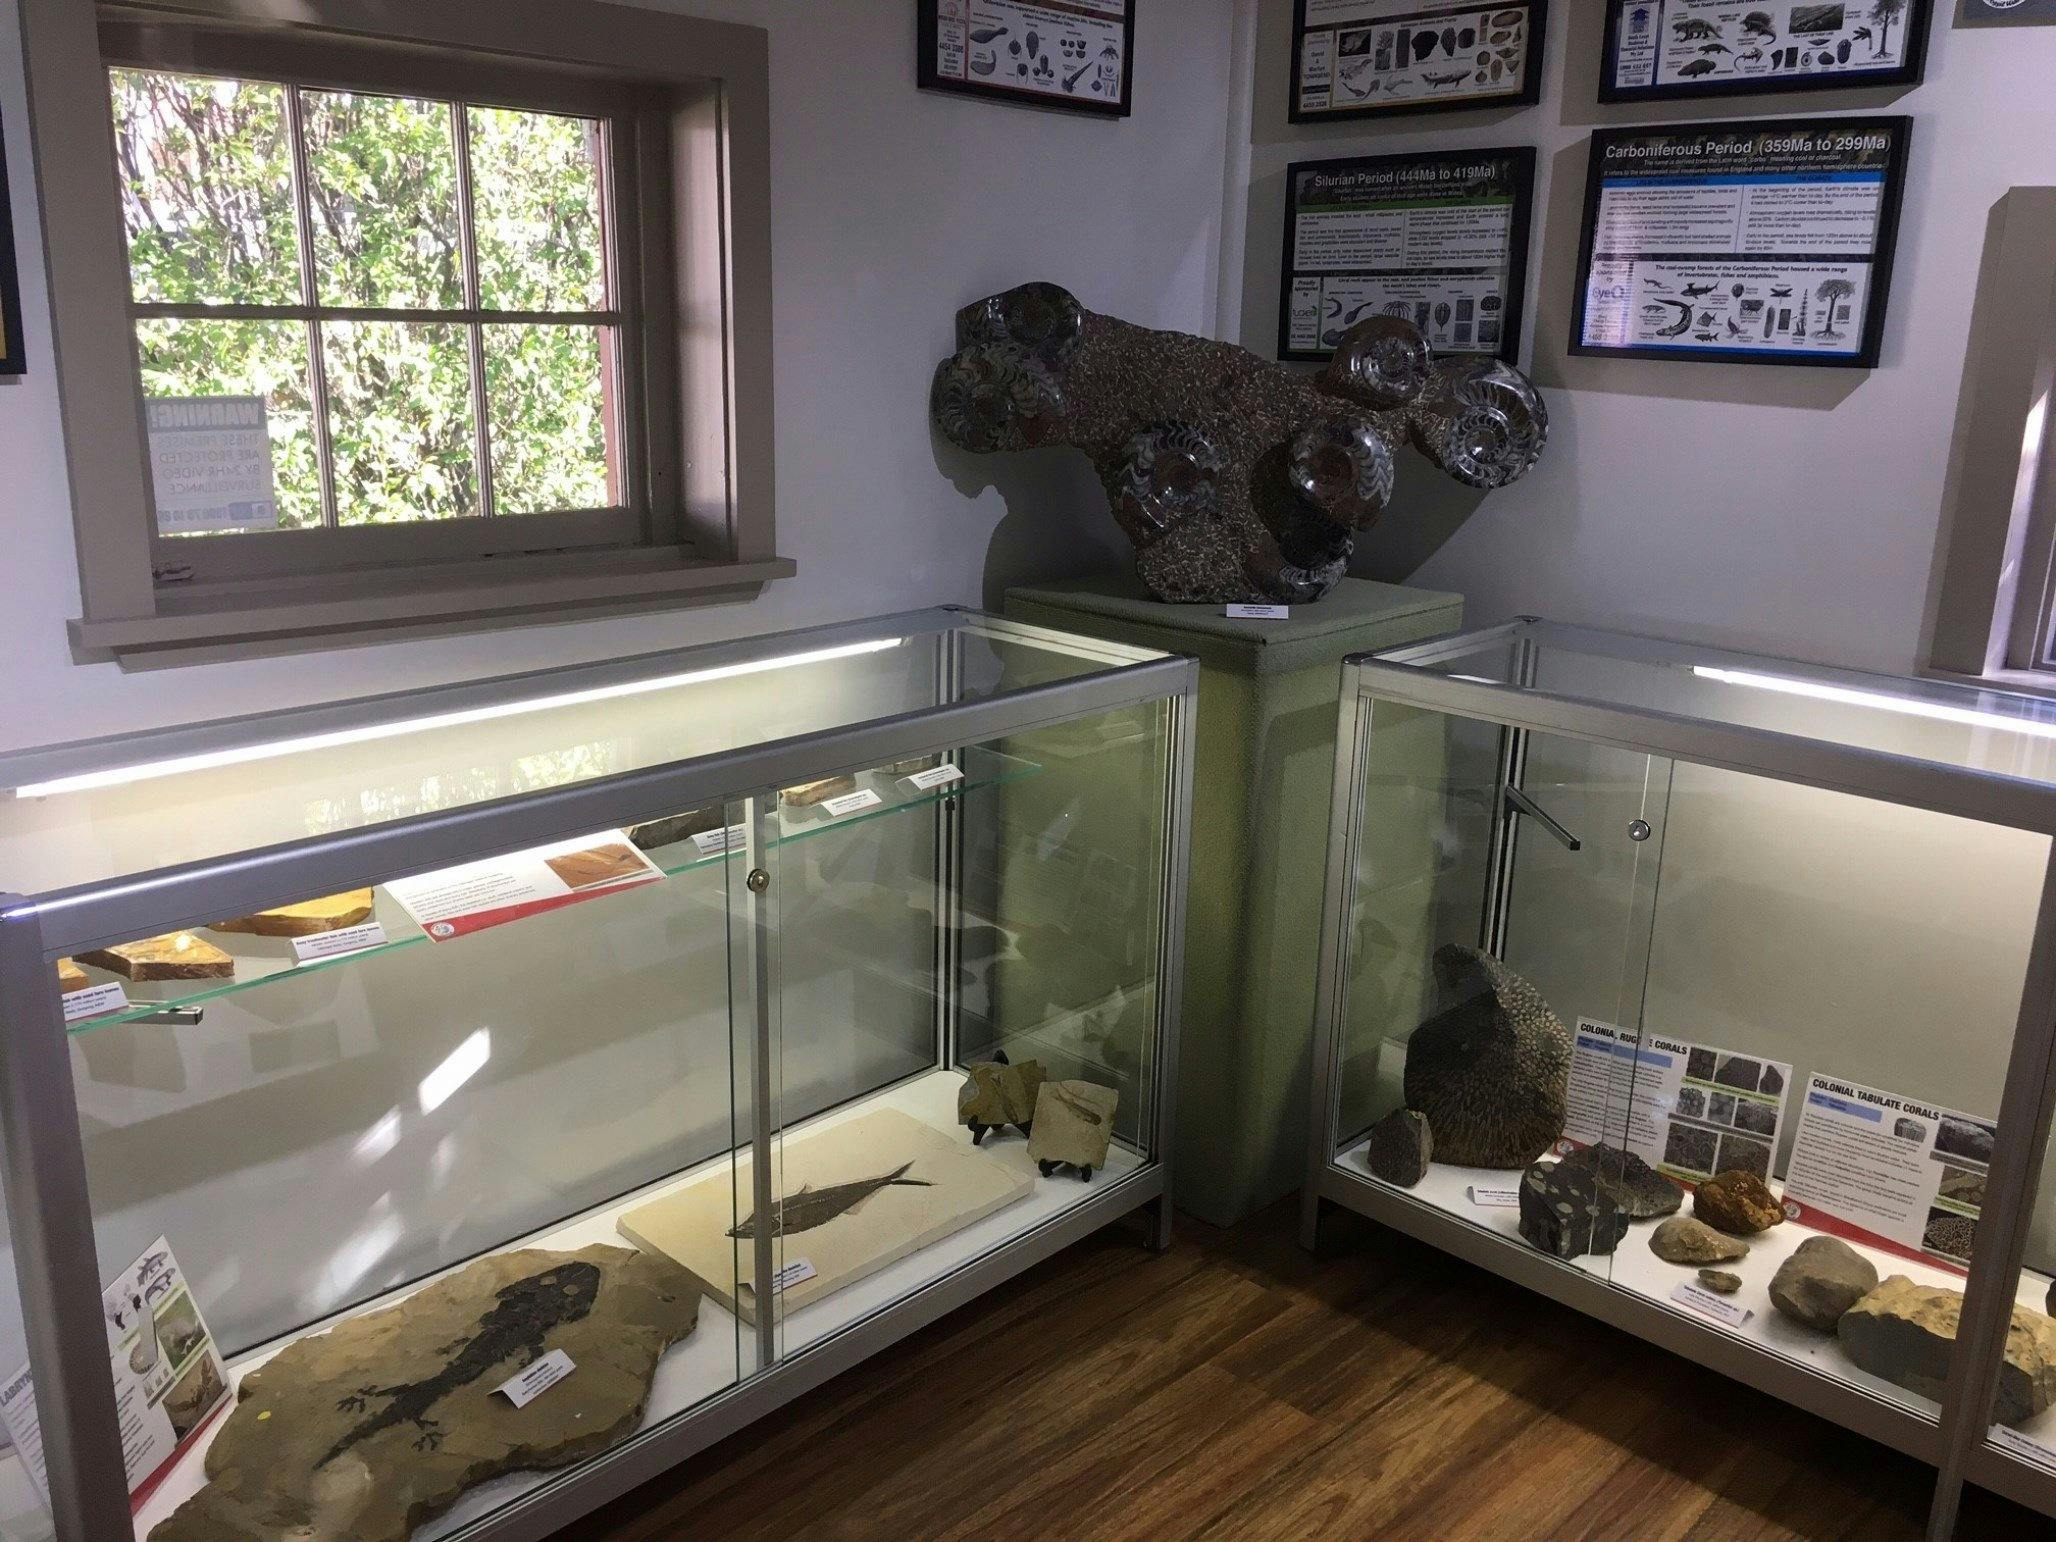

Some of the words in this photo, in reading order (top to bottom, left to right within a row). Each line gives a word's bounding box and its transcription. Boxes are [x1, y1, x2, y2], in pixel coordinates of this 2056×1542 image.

[1606, 143, 1702, 159] Carboniferous
[1706, 140, 1752, 155] Period
[1759, 138, 1812, 155] (359Ma
[1816, 139, 1831, 152] to
[1835, 134, 1891, 152] 299Ma)
[1315, 174, 1355, 187] Silurian
[1358, 171, 1393, 184] Period
[1396, 169, 1436, 184] (444Ma
[1439, 169, 1450, 180] to
[1454, 166, 1495, 180] 419Ma)
[1580, 1023, 1618, 1040] COLONIA
[1655, 1040, 1688, 1055] CORALS
[1812, 1078, 1855, 1098] COLONIAL
[1857, 1090, 1902, 1110] TABULATE
[1903, 1102, 1940, 1121] CORALS
